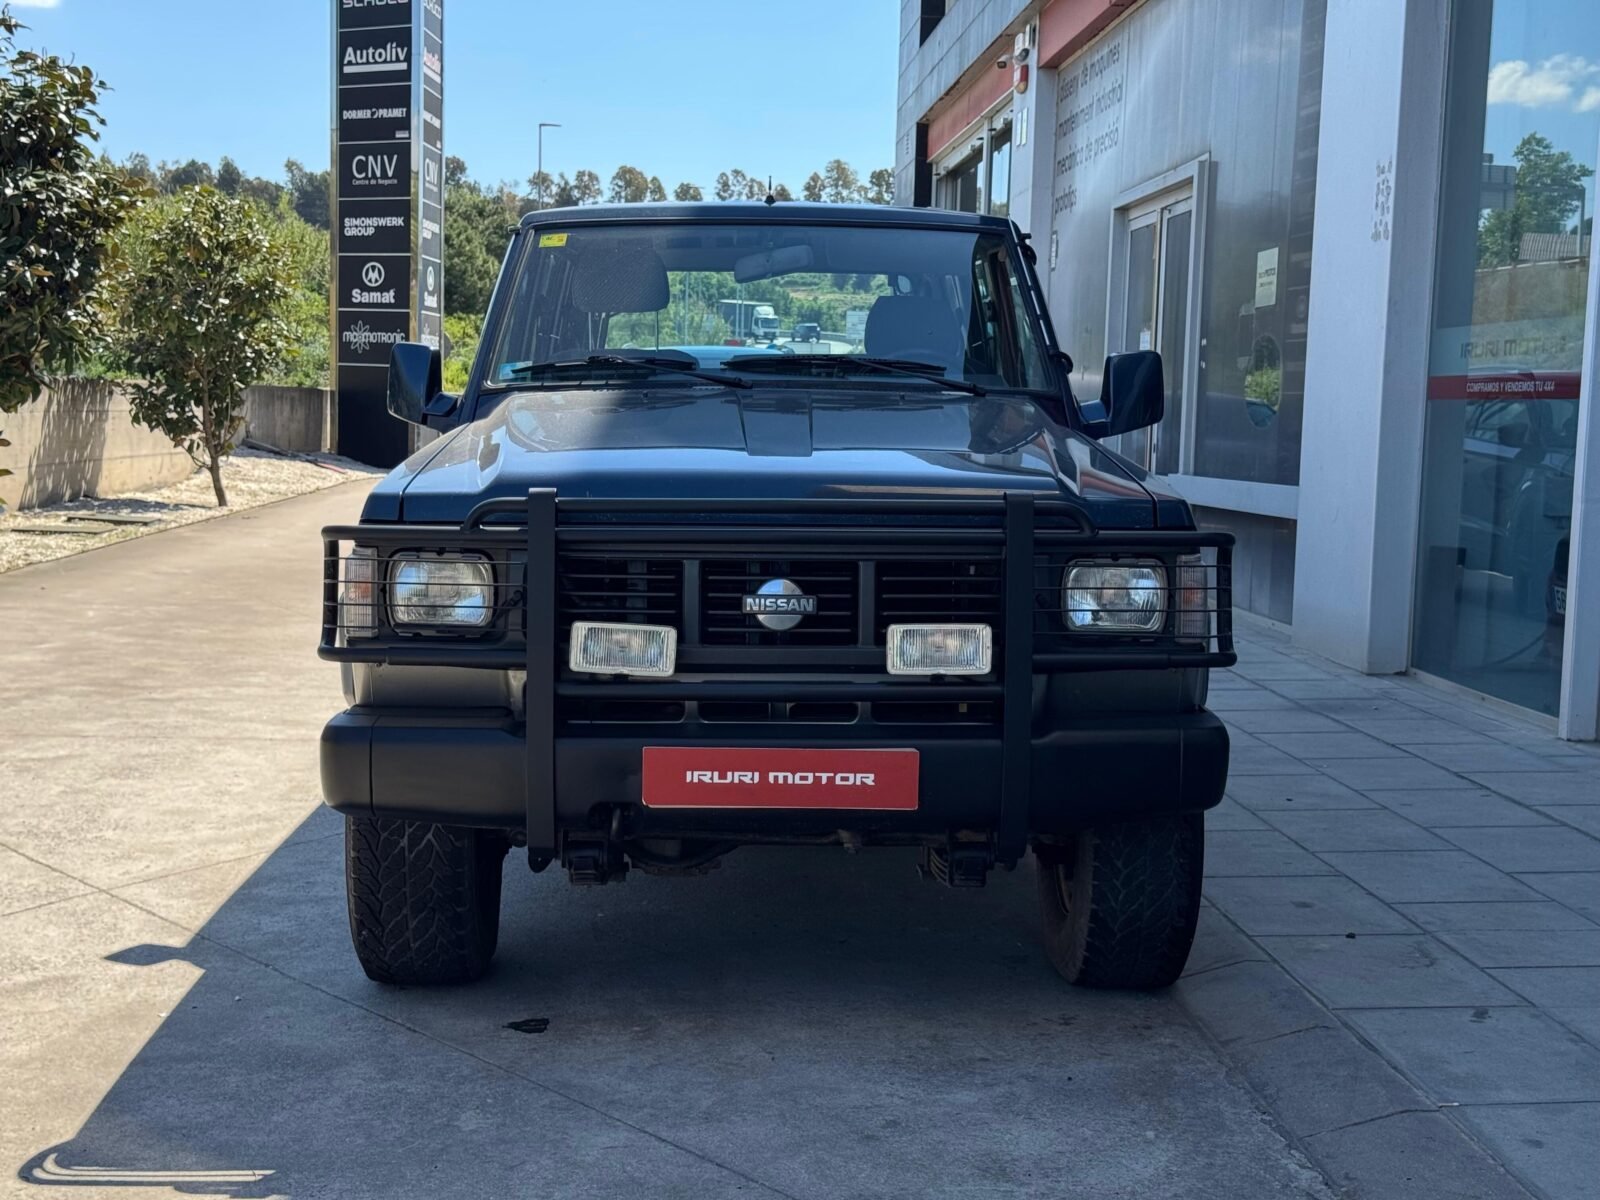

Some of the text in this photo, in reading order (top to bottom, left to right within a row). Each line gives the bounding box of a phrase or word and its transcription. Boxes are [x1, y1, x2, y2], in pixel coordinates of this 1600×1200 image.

[344, 42, 407, 64] Autoliv
[343, 107, 406, 120] DORMER PRAMET
[352, 154, 398, 178] CNV
[344, 216, 404, 227] SIMONSWERK
[344, 226, 375, 236] GROUP
[351, 288, 395, 303] Samat
[1466, 382, 1499, 392] COMPRAMOS
[1504, 381, 1535, 392] VENDEMOS
[1536, 381, 1543, 391] TU
[746, 598, 814, 611] NISSAN
[686, 771, 875, 785] IRURI MOTOR
